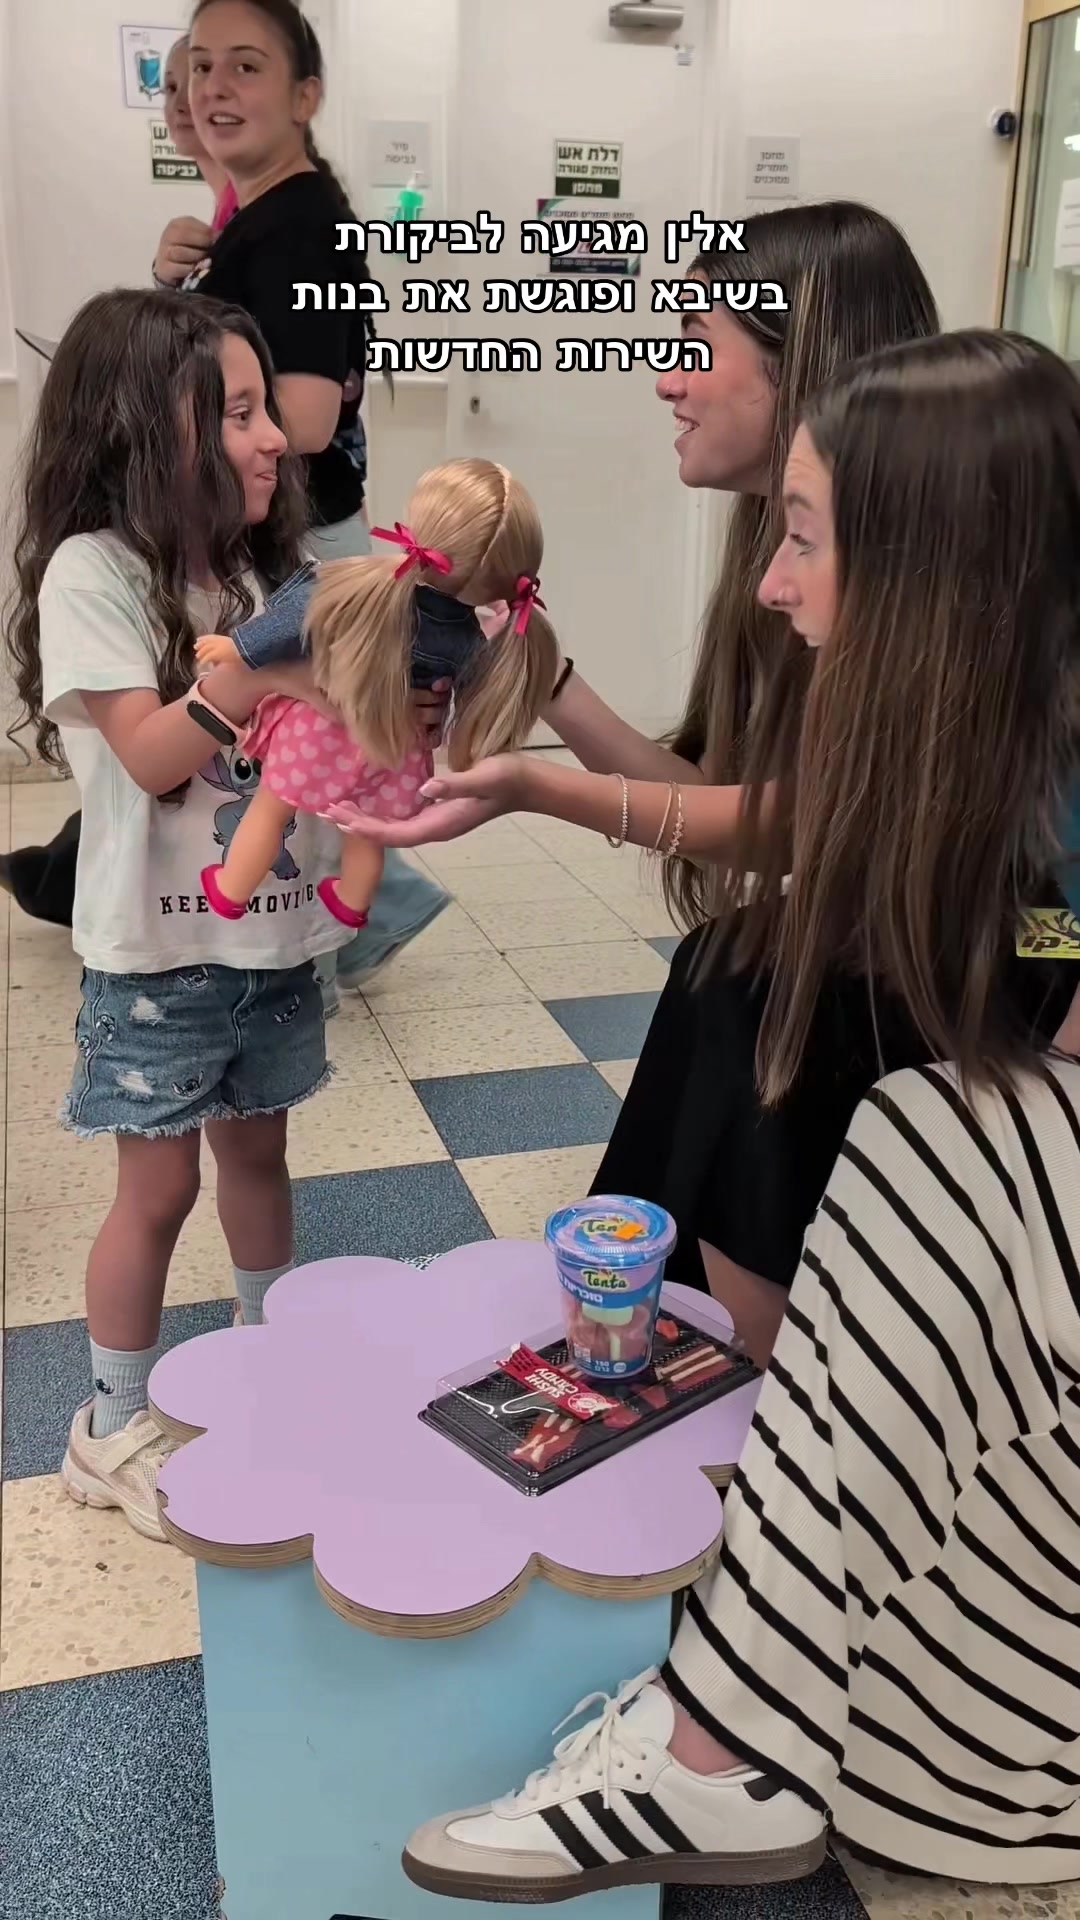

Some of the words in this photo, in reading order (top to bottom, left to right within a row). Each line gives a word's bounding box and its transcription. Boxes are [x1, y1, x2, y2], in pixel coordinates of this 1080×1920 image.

[558, 145, 584, 160] אש
[588, 146, 620, 162] דלת
[572, 181, 603, 195] מחסן
[159, 895, 209, 914] KEE
[582, 1269, 628, 1289] Tenta
[525, 1373, 566, 1399] SUSHI
[534, 1368, 579, 1394] CANDY
